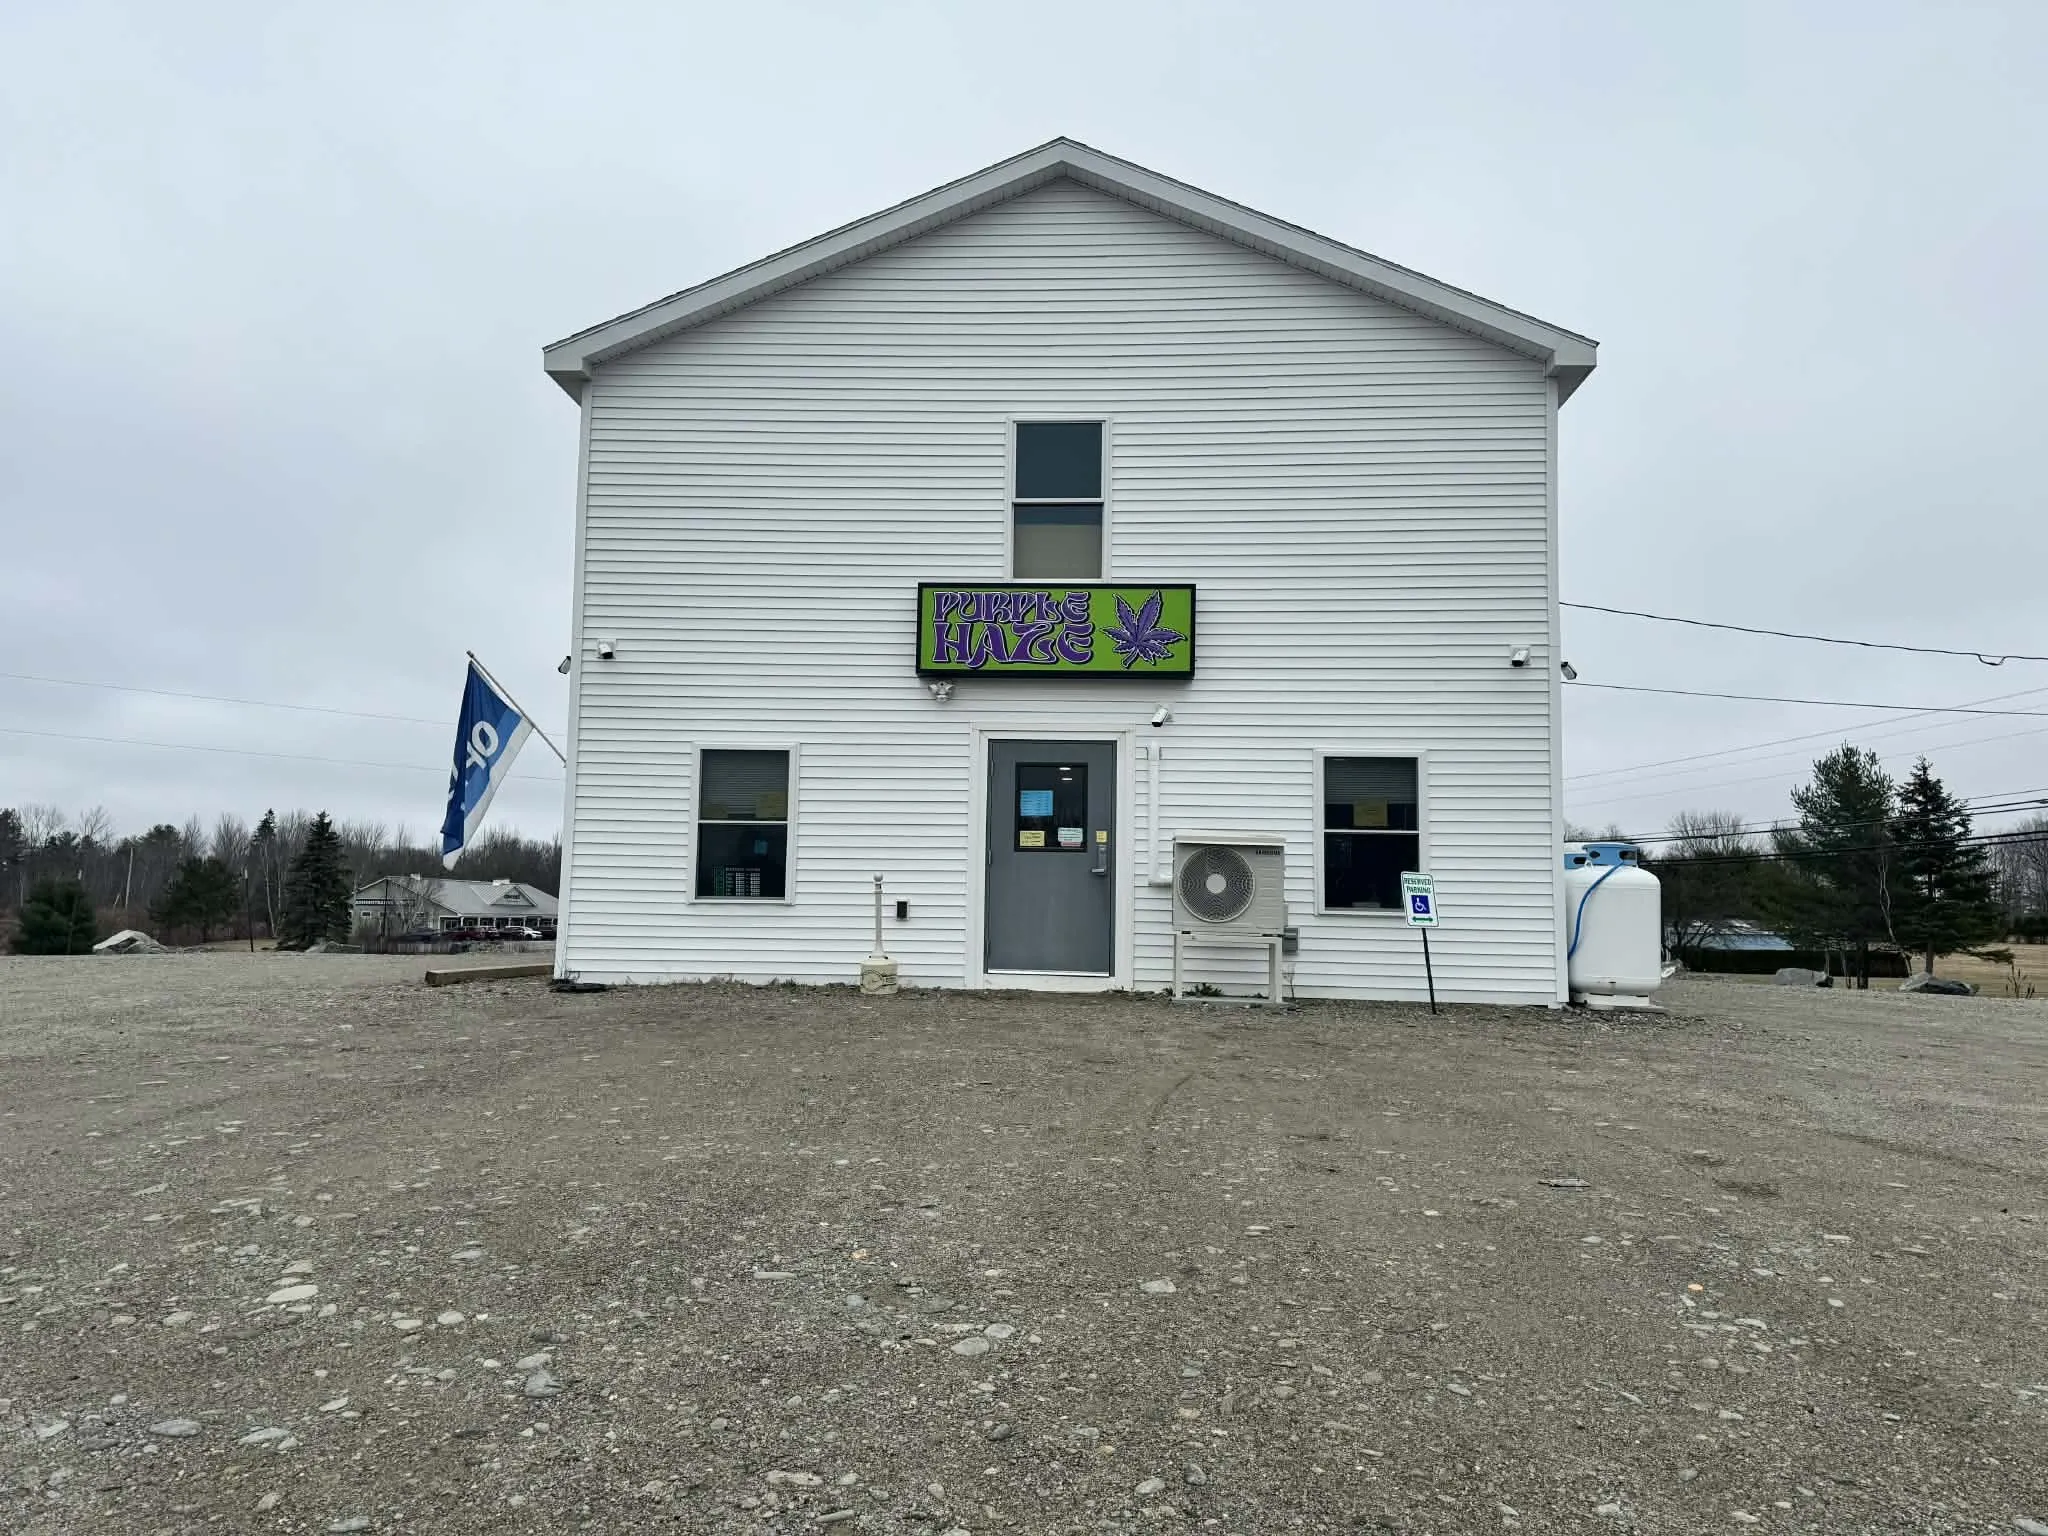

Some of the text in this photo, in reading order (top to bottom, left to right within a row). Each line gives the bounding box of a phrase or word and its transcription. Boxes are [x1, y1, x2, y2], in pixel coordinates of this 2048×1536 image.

[933, 591, 1089, 622] PURPLE
[932, 622, 1094, 668] HAZE
[1406, 885, 1431, 893] PARKING
